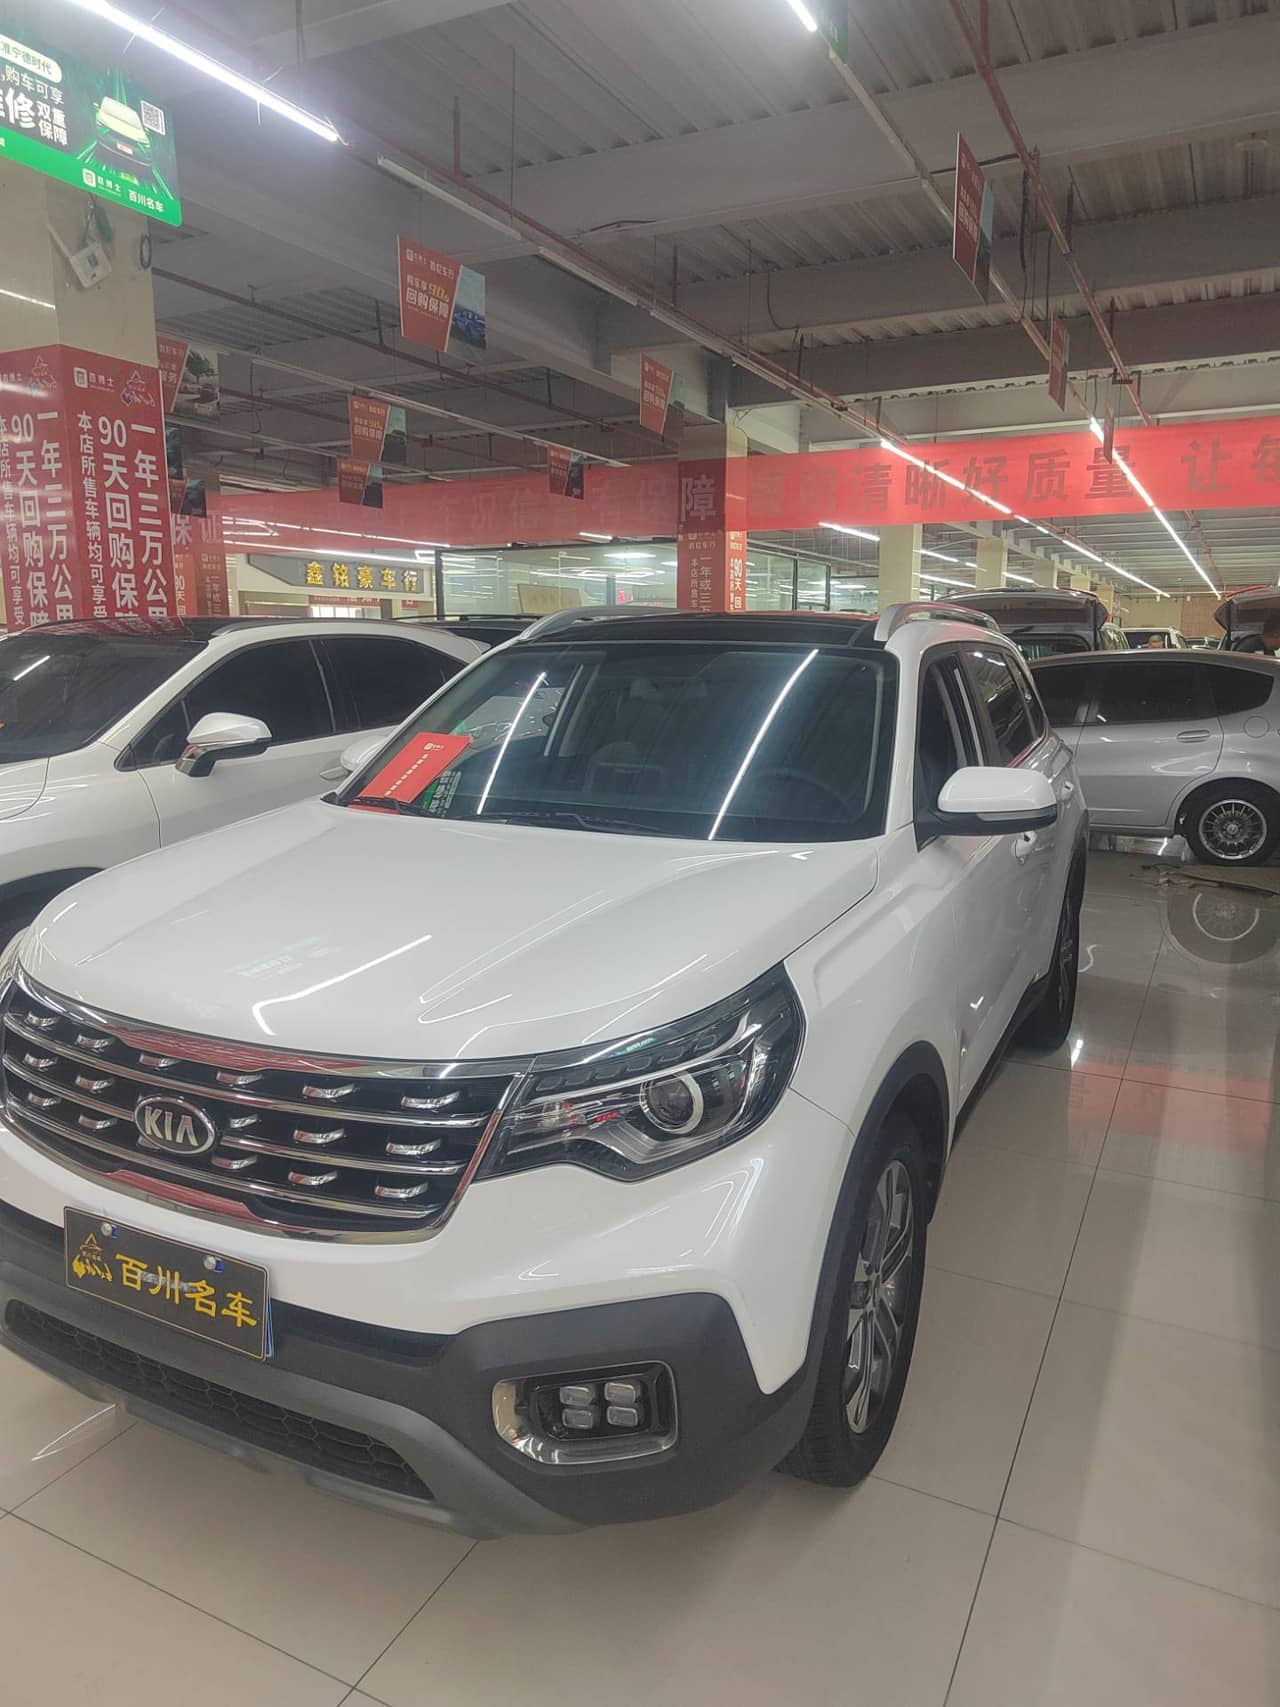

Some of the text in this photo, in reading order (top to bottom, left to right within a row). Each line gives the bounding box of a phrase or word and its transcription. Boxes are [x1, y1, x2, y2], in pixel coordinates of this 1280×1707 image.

[128, 189, 165, 213] 百川名车
[77, 410, 107, 618] 本店所售车辆均可享受
[98, 415, 135, 618] 90天回购保
[304, 561, 420, 593] 鑫铭豪车行
[144, 1106, 200, 1147] KIA
[115, 1253, 258, 1328] 百川名车
